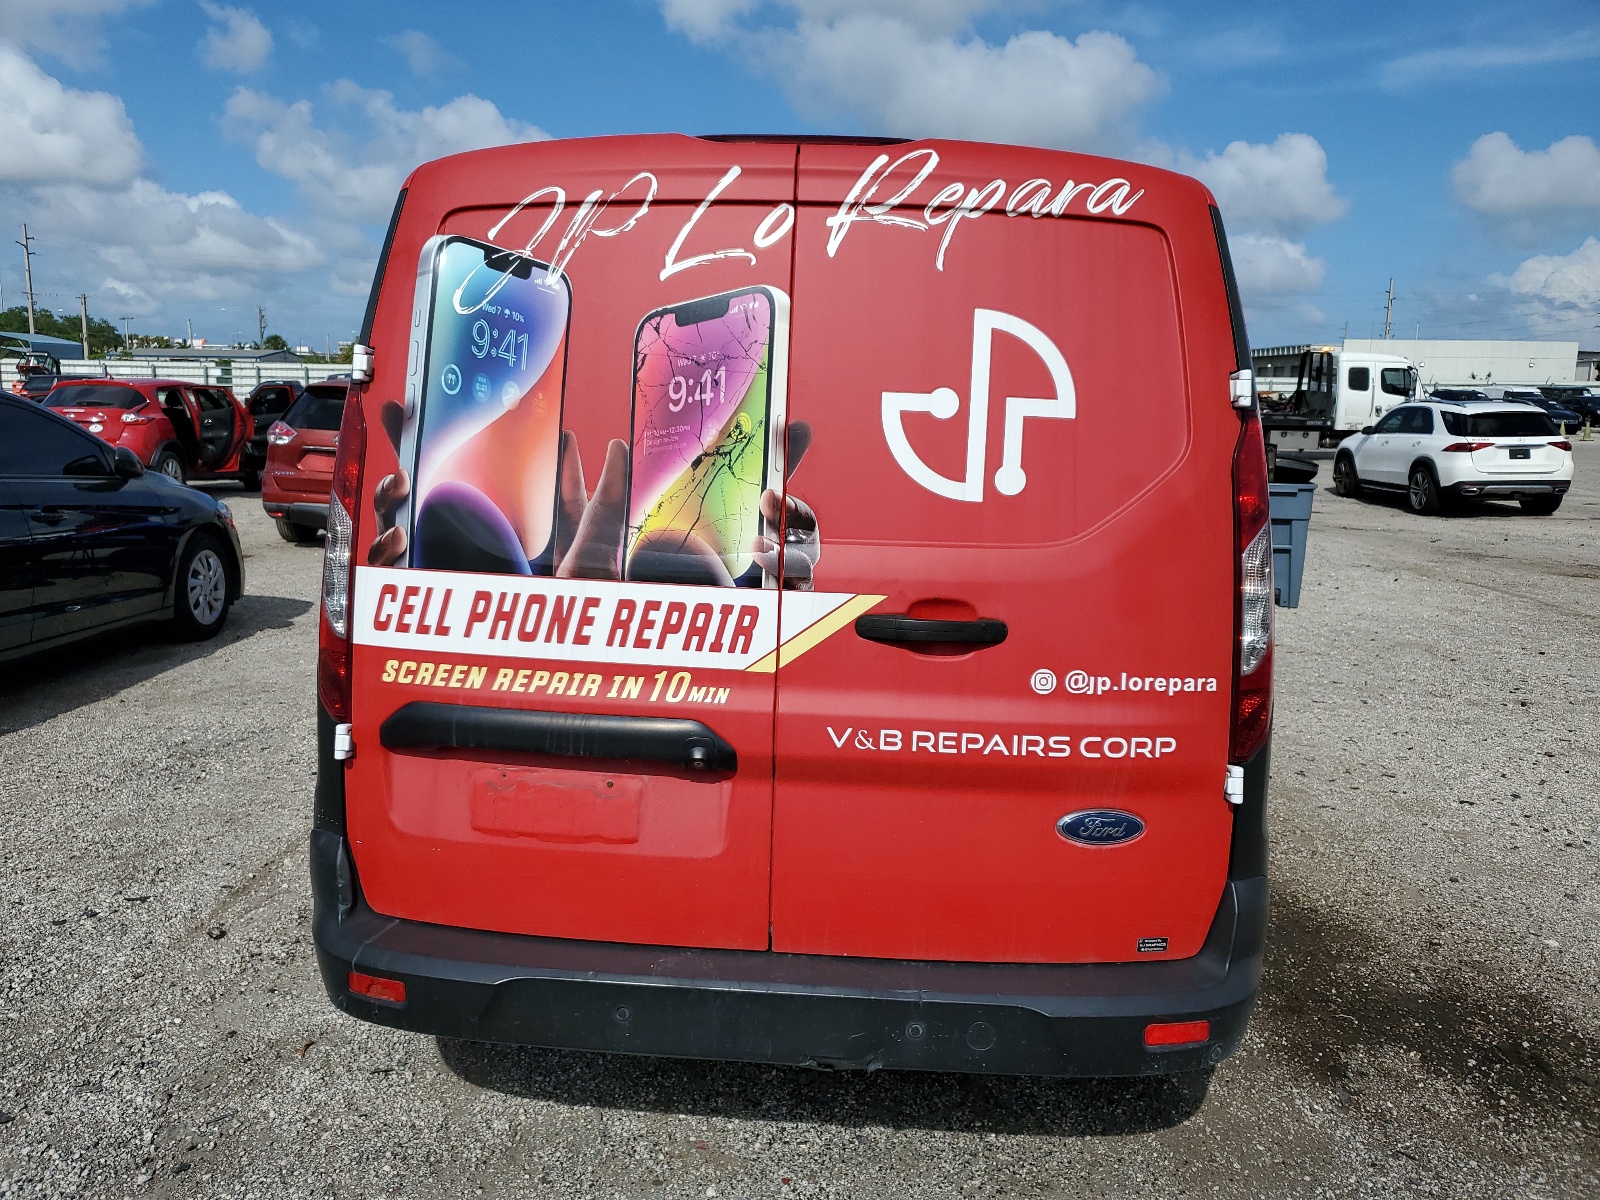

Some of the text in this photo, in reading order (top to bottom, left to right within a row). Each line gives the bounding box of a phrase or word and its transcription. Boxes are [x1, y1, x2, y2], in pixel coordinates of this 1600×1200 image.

[659, 165, 796, 282] Lo
[826, 149, 1145, 272] Repara
[471, 318, 529, 371] 9:41
[668, 365, 727, 413] 9:41
[373, 583, 761, 655] CELL PHONE REPAIR
[381, 659, 489, 690] SCREEN
[491, 668, 603, 697] REPAIR
[606, 675, 646, 699] IN
[1064, 669, 1218, 696] @jp.lorepara
[826, 726, 1178, 759] V&B REPAIRS CORP
[1078, 817, 1127, 838] Ford
